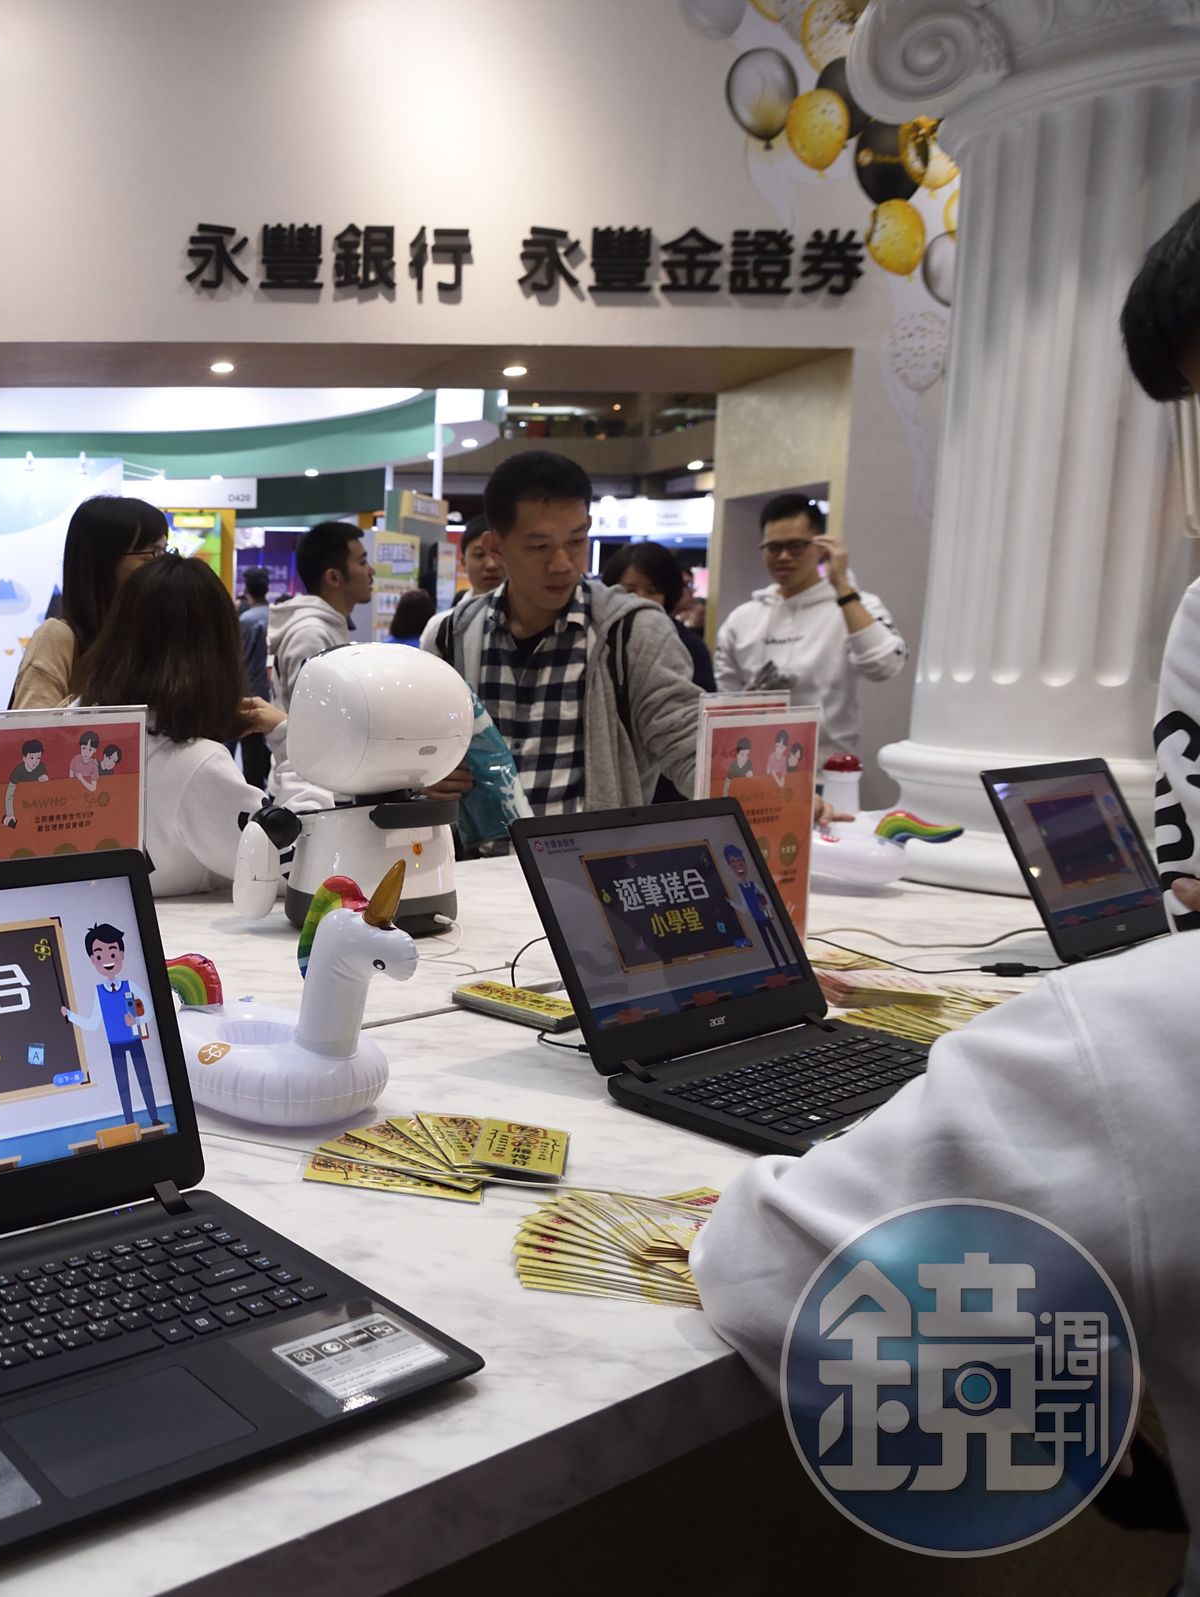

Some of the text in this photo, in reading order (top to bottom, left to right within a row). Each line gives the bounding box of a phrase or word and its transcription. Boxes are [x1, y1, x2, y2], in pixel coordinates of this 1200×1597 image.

[185, 222, 866, 296] 永豐銀行 永豐金證券
[651, 907, 704, 938] 小學堂
[708, 1015, 727, 1028] acer
